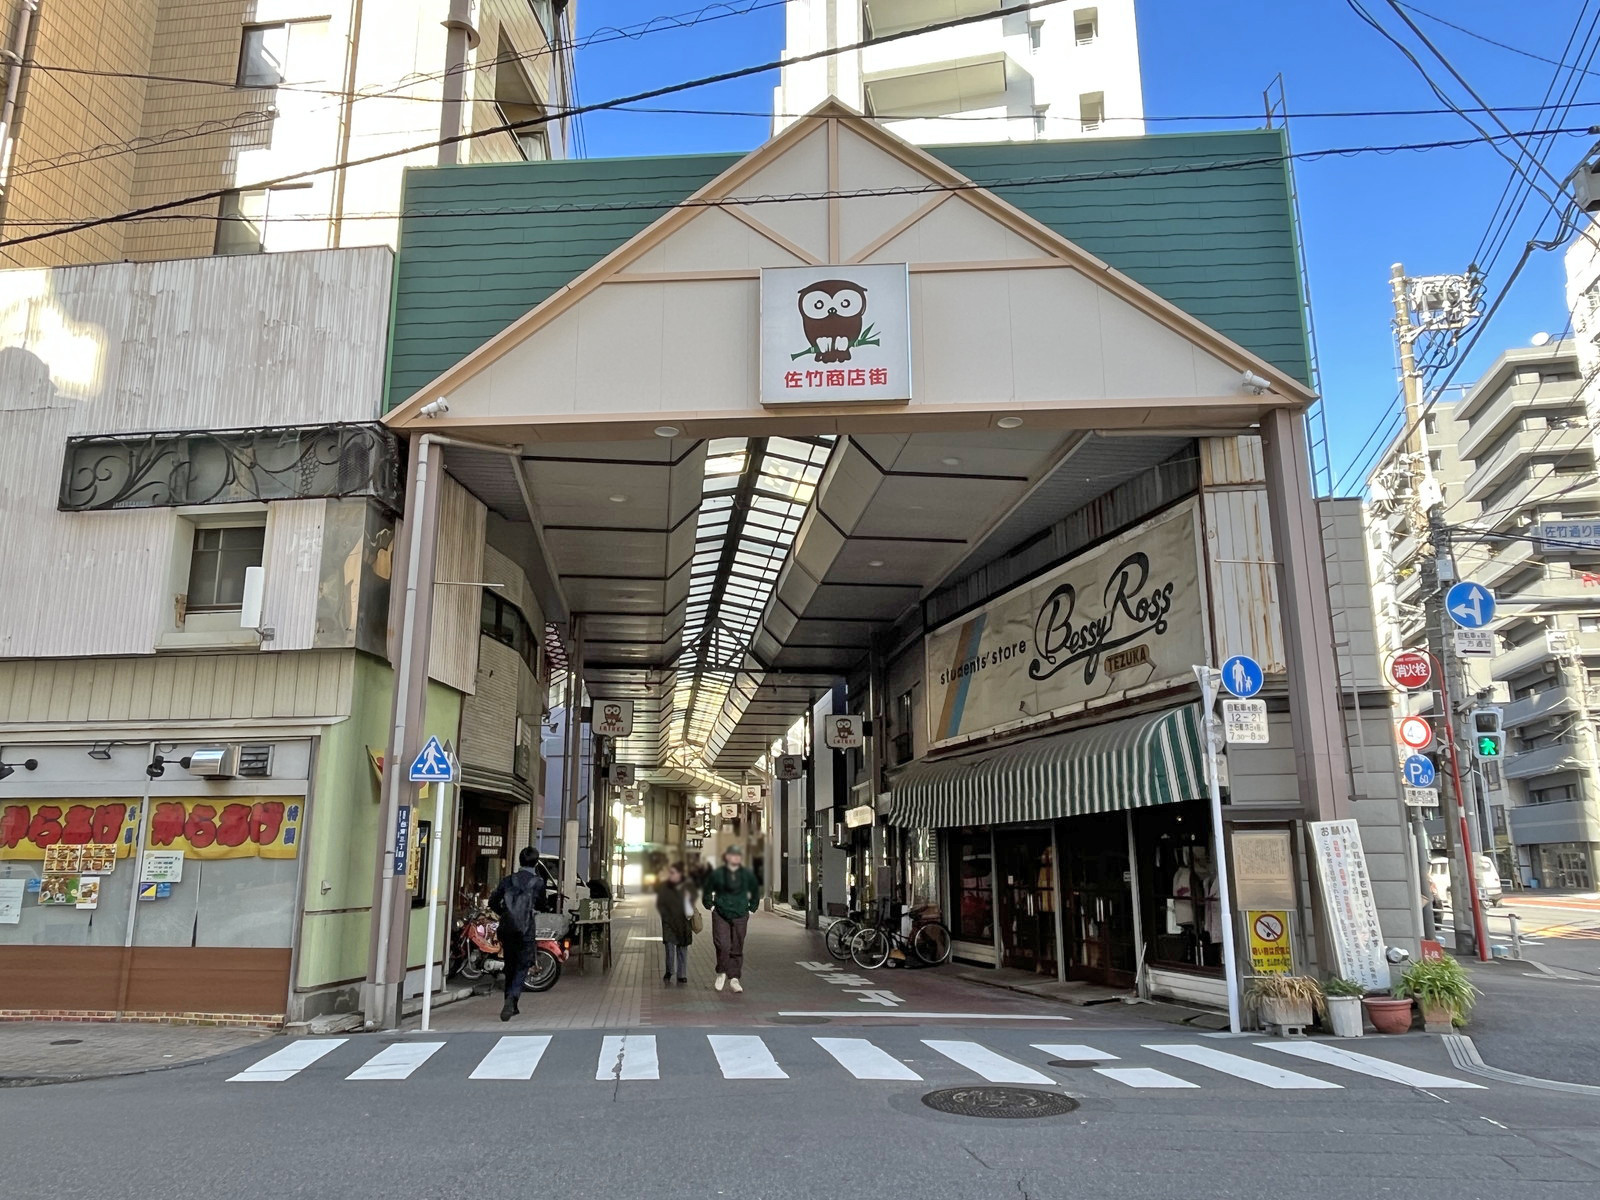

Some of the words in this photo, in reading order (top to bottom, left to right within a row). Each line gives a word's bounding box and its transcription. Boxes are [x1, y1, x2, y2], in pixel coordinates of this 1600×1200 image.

[784, 368, 888, 389] 佐竹商店街
[1104, 552, 1174, 635] Ross
[1106, 647, 1147, 672] TEZUKA
[1394, 662, 1428, 678] 消火栓
[1227, 703, 1263, 712] 自転車を除く
[151, 802, 285, 849] からあげ
[1320, 825, 1351, 837] お願い
